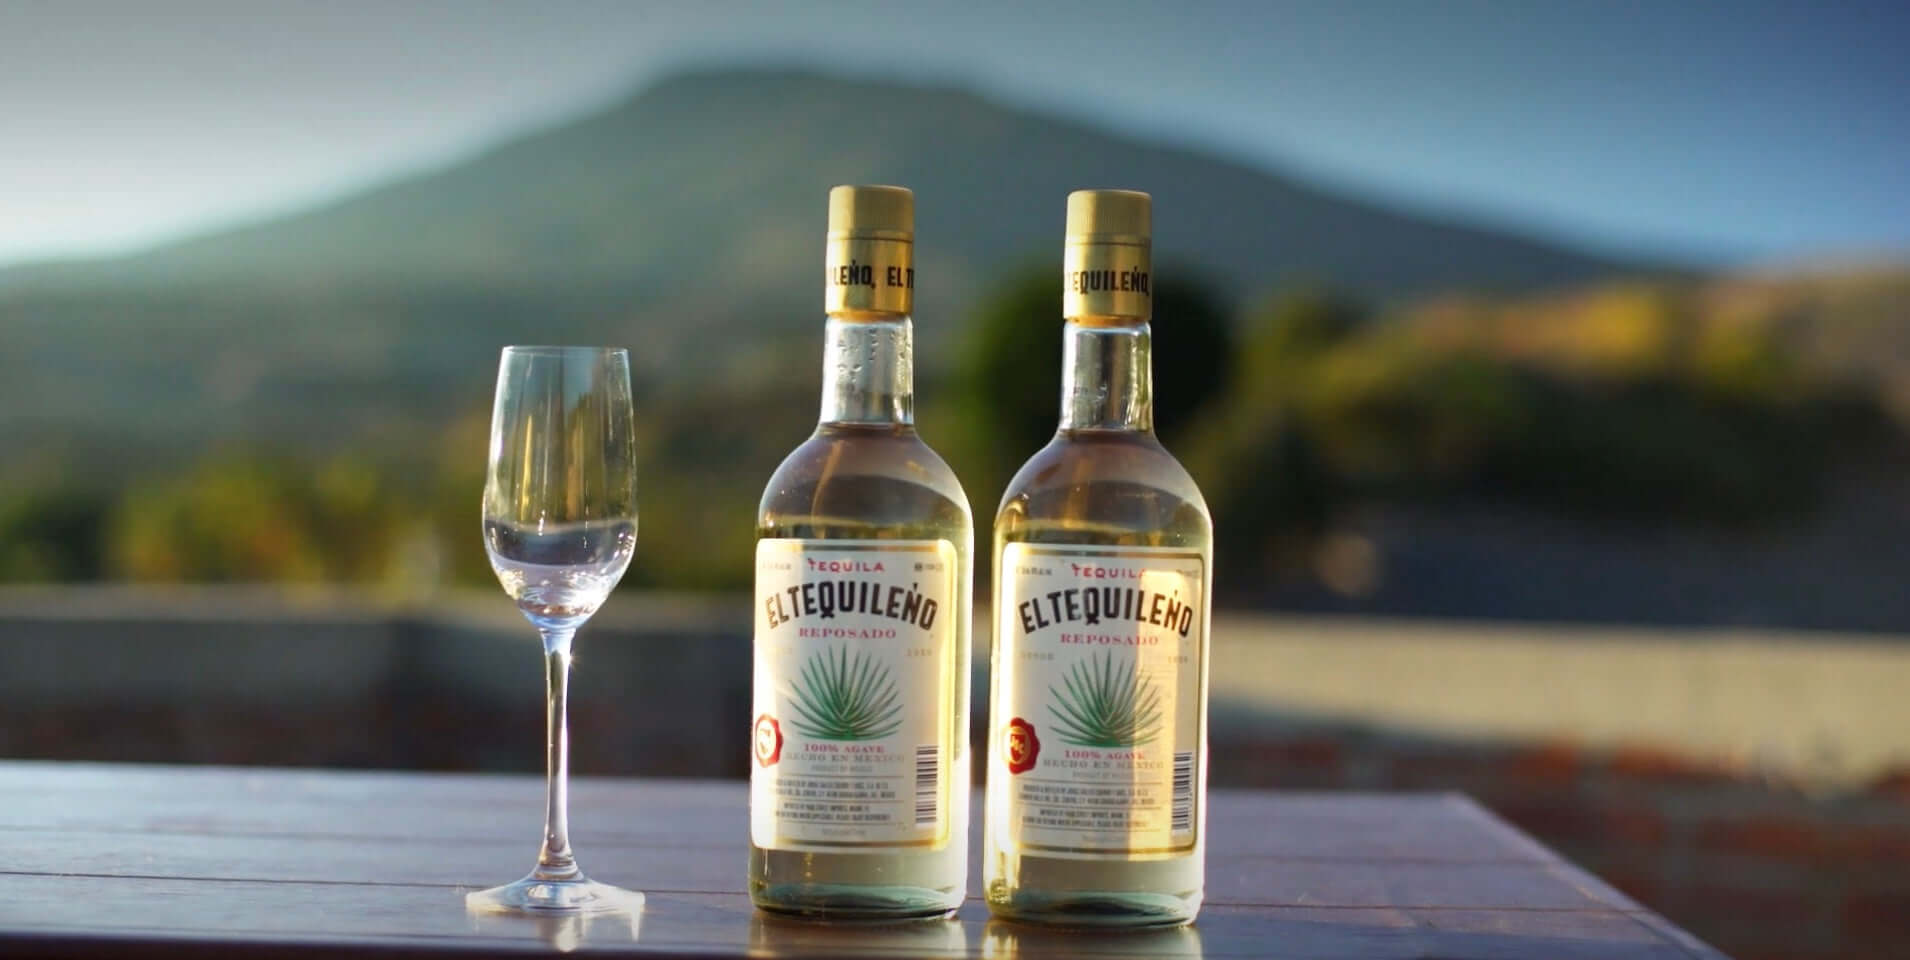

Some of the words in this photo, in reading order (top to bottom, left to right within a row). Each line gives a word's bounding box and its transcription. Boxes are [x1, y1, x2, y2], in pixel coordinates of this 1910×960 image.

[807, 557, 885, 572] TEQUILA
[1071, 563, 1146, 578] TEQUILA
[799, 627, 897, 639] REPOSADO
[1060, 633, 1159, 646] REPOSADO
[804, 743, 839, 753] 100%
[844, 744, 885, 753] AGAVE
[1064, 749, 1102, 760] 100%
